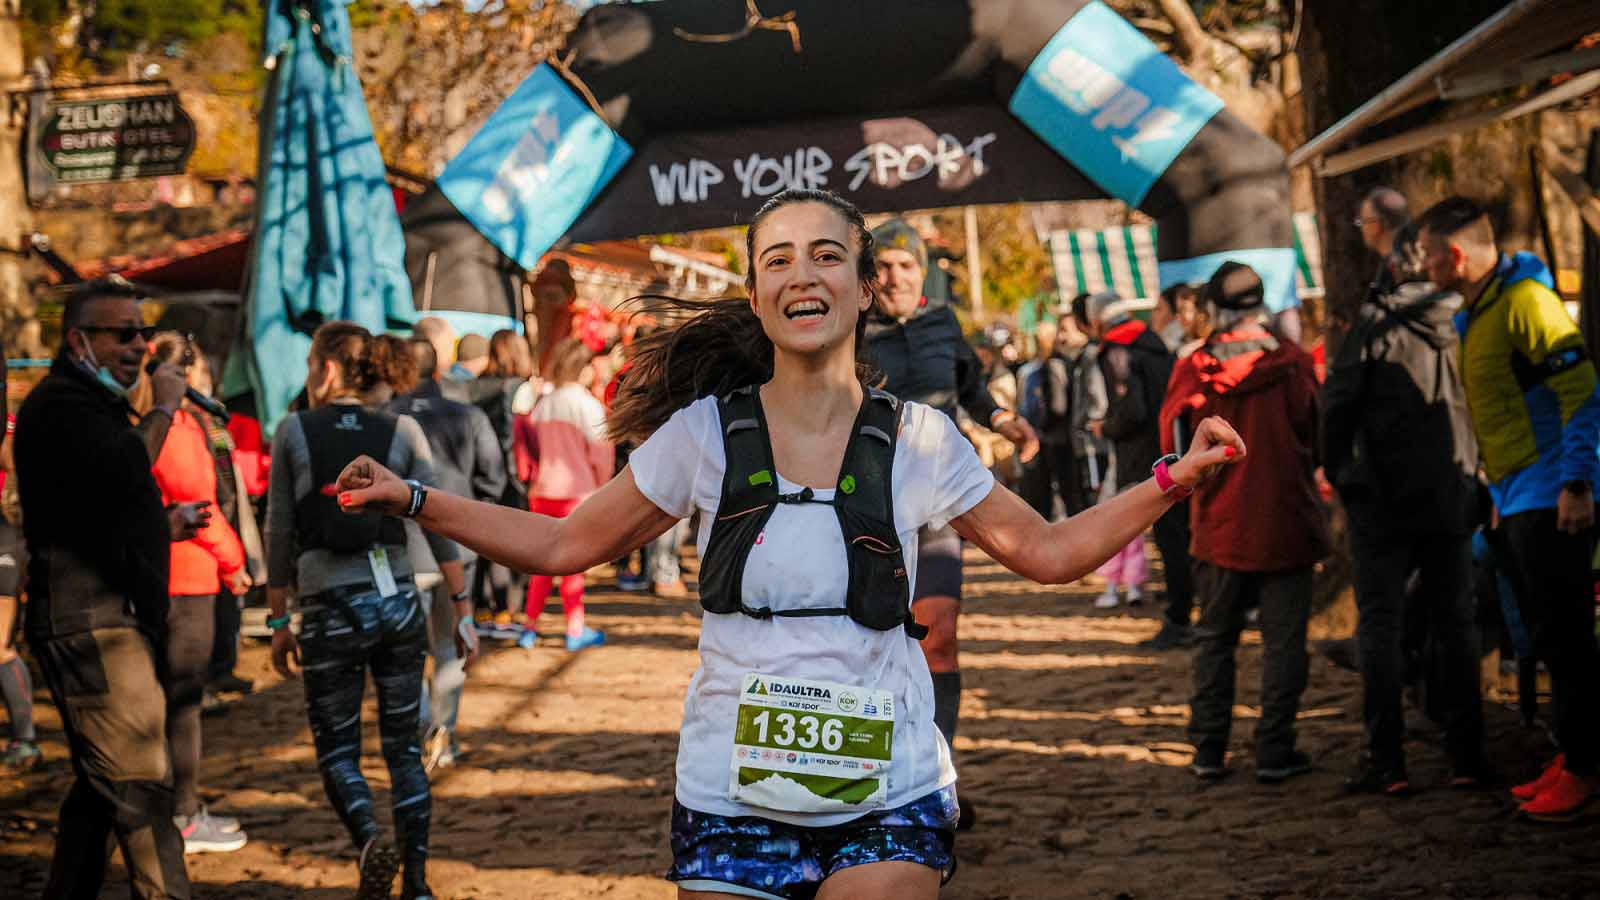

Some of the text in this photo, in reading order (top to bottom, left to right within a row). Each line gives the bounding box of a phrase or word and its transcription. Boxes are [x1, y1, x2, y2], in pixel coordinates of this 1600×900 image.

[650, 133, 996, 206] WUP YOUR SPORT
[769, 682, 831, 698] IDAULTRA
[753, 710, 844, 751] 1336
